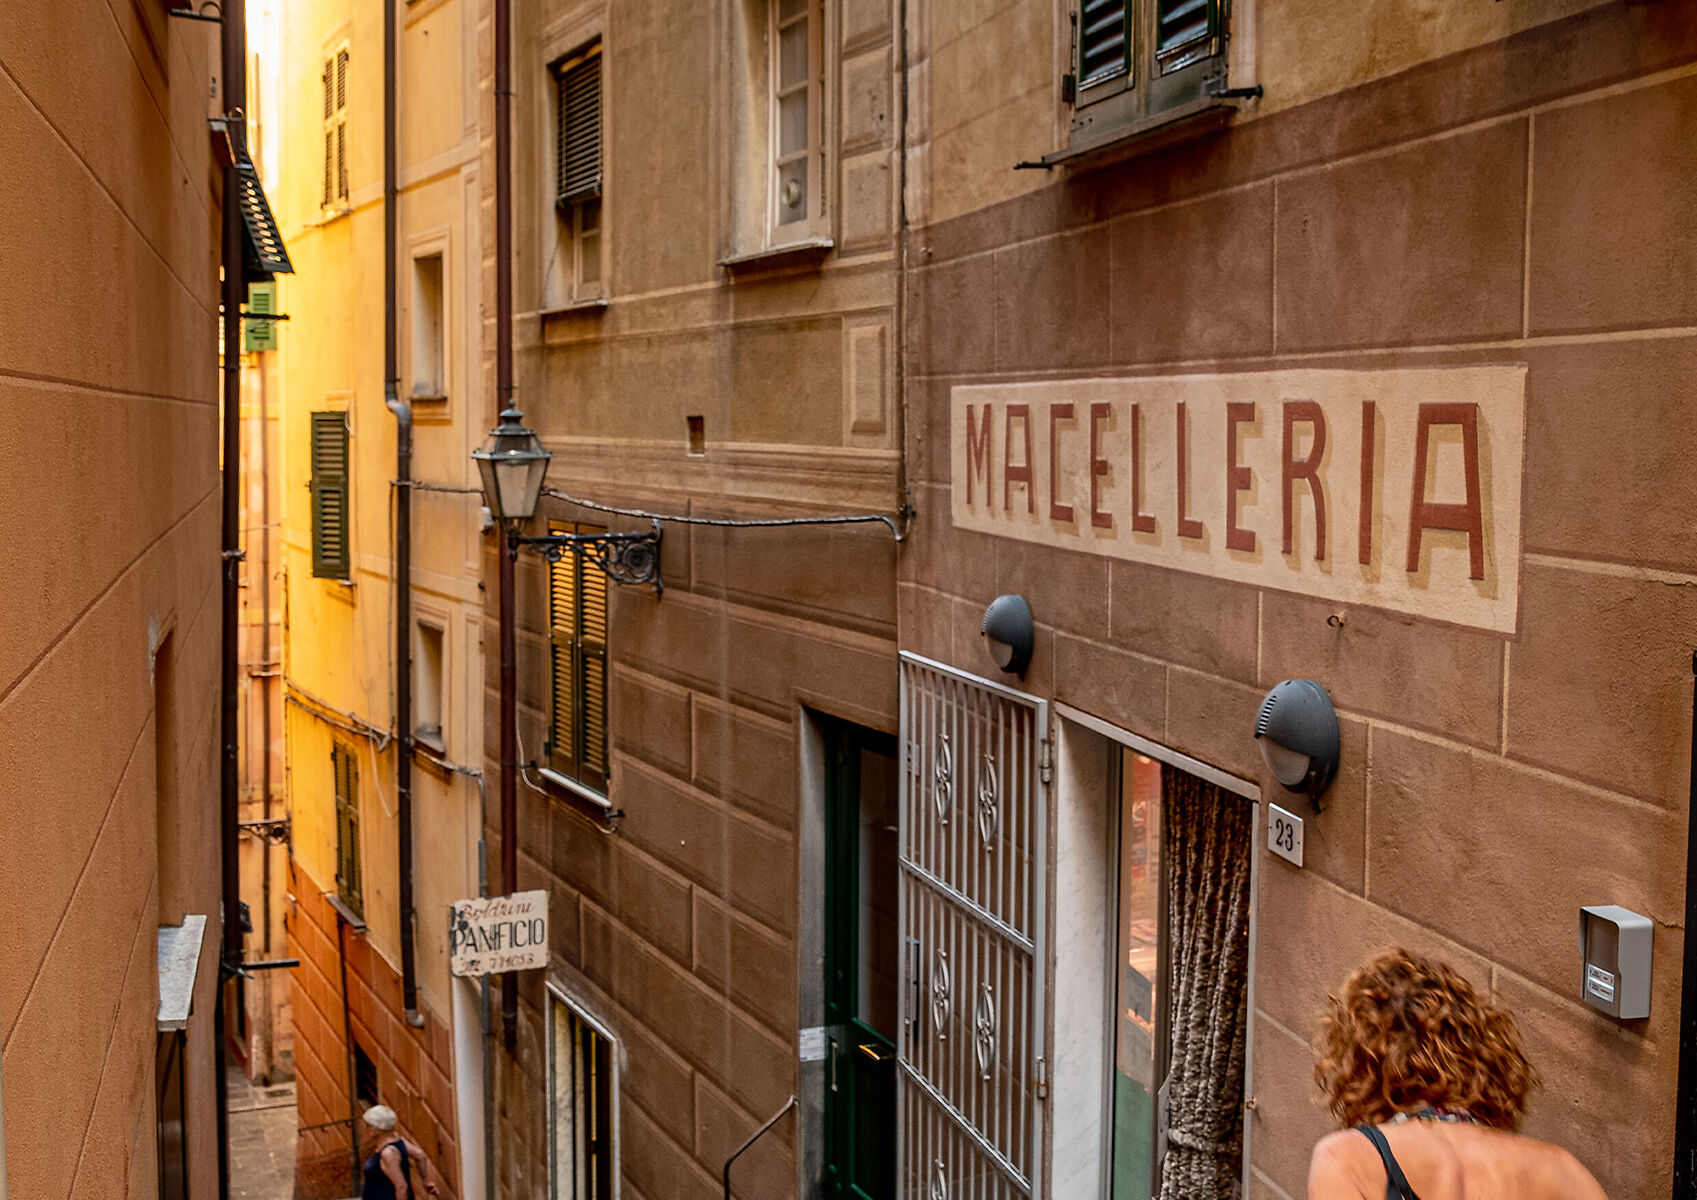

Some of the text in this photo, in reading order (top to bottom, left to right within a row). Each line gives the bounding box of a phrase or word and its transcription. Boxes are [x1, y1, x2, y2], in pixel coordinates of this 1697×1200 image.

[966, 399, 1485, 581] MACELLERIA
[1275, 818, 1294, 852] 23
[450, 917, 545, 955] PANIFICIO
